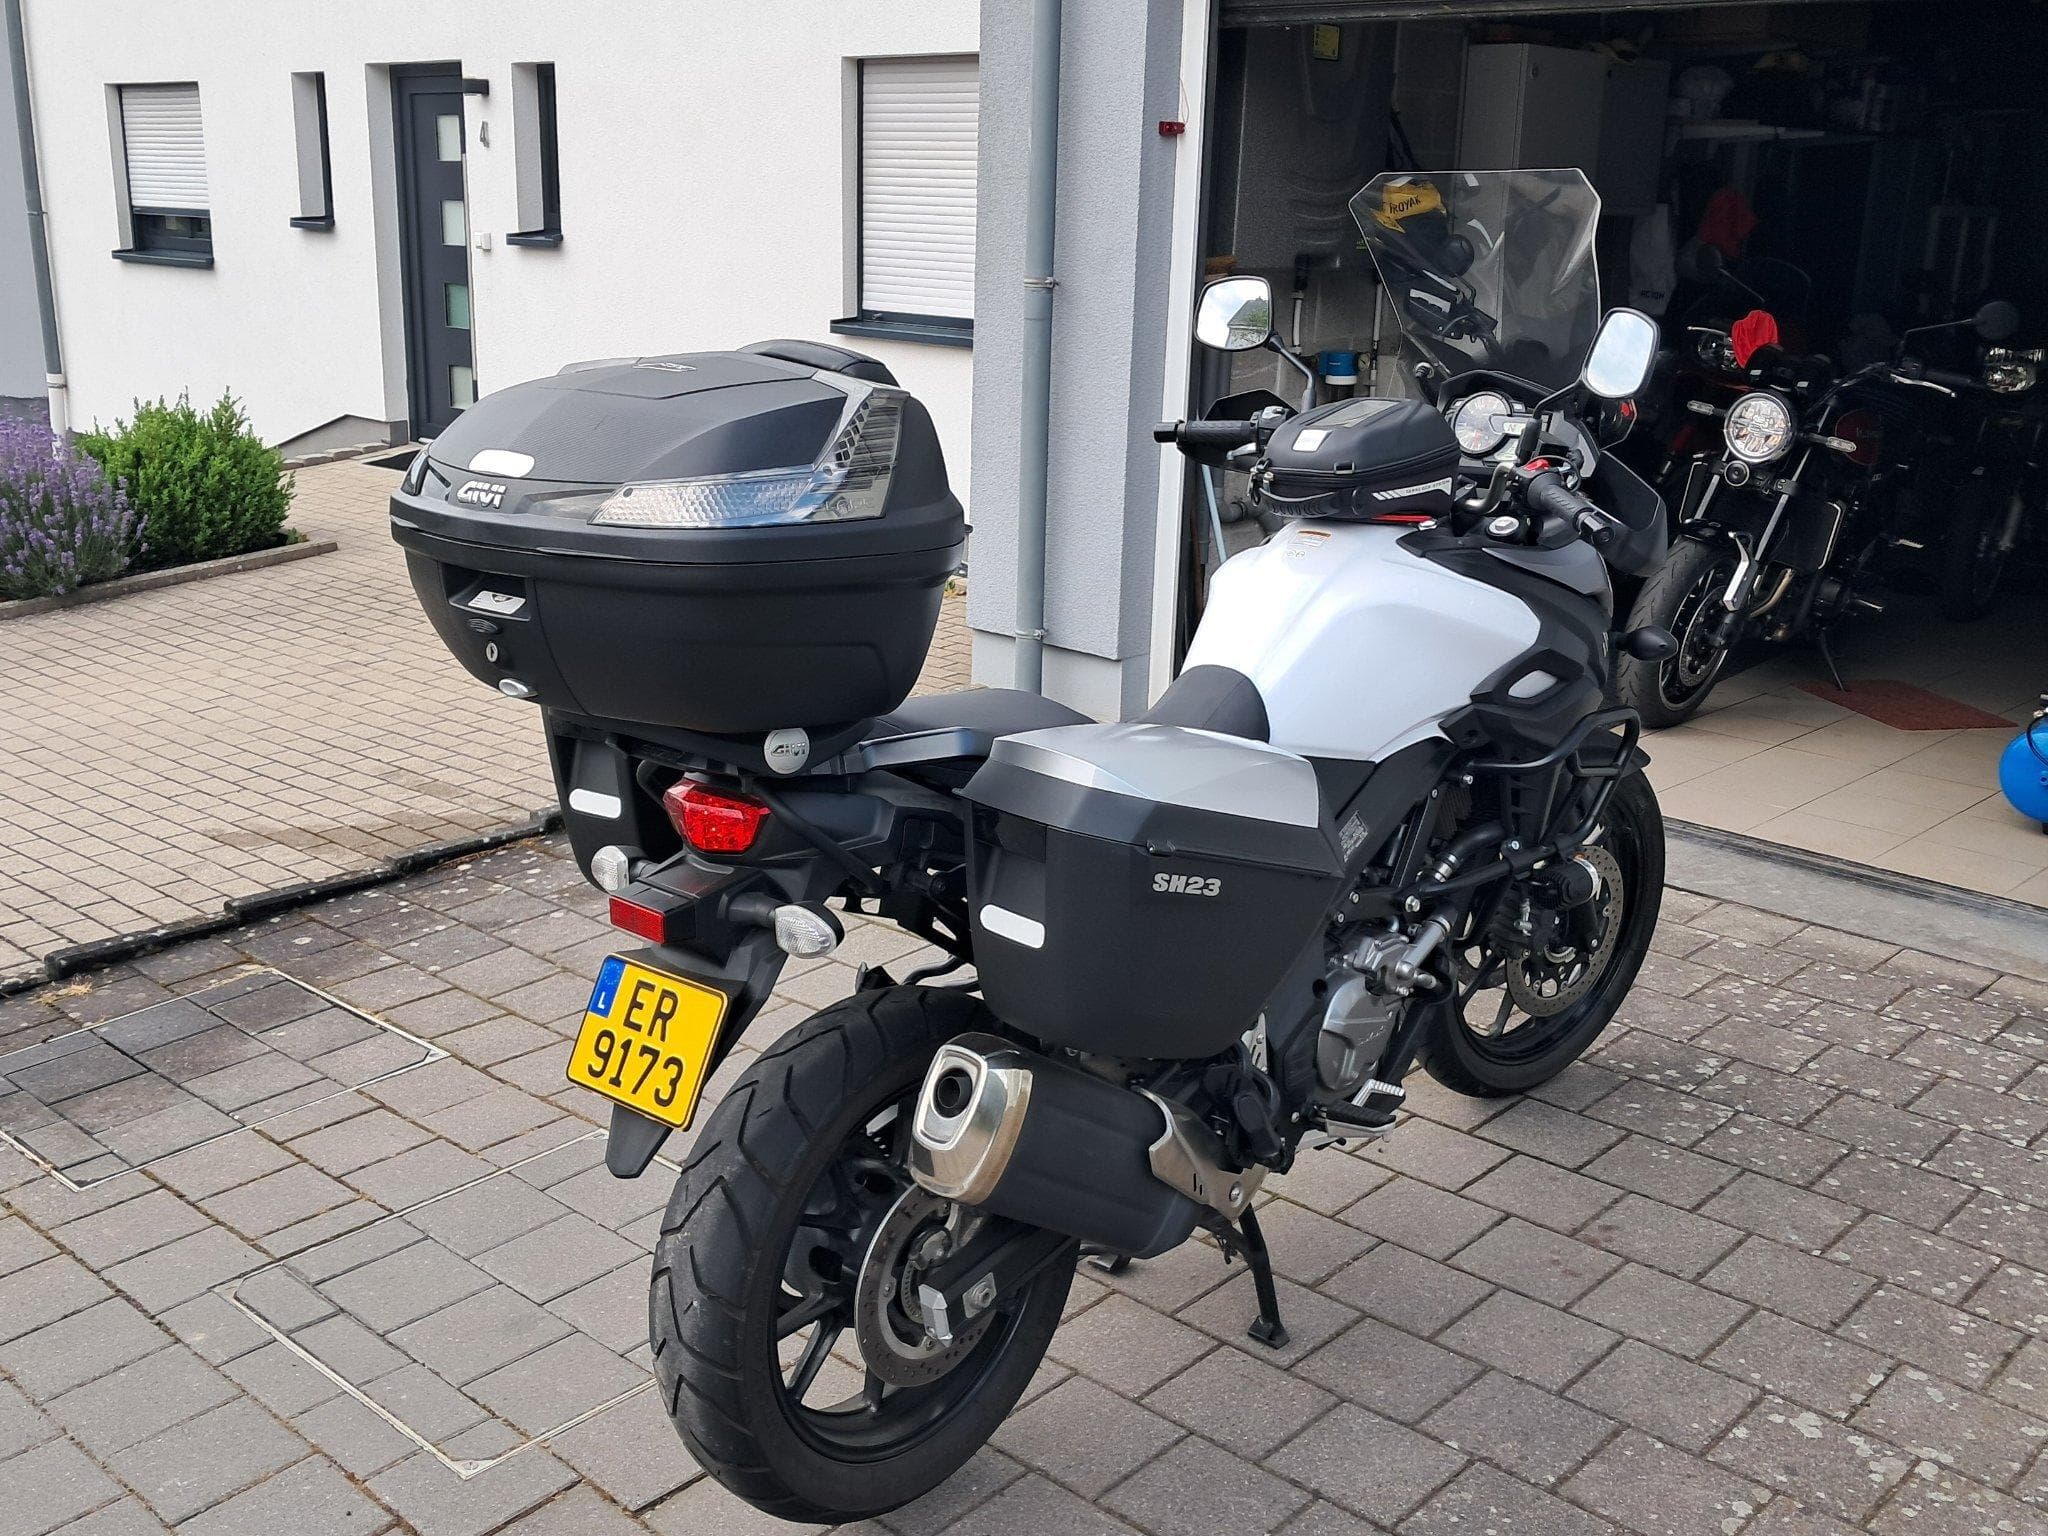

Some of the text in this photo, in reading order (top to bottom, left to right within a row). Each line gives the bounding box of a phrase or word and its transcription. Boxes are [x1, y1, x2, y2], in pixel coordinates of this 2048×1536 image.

[480, 121, 489, 148] 4
[457, 480, 507, 508] GIVI
[771, 742, 806, 757] GIVI
[1152, 872, 1222, 897] SH23
[598, 991, 605, 1009] L
[623, 979, 679, 1042] ER
[587, 1029, 684, 1107] 9173
